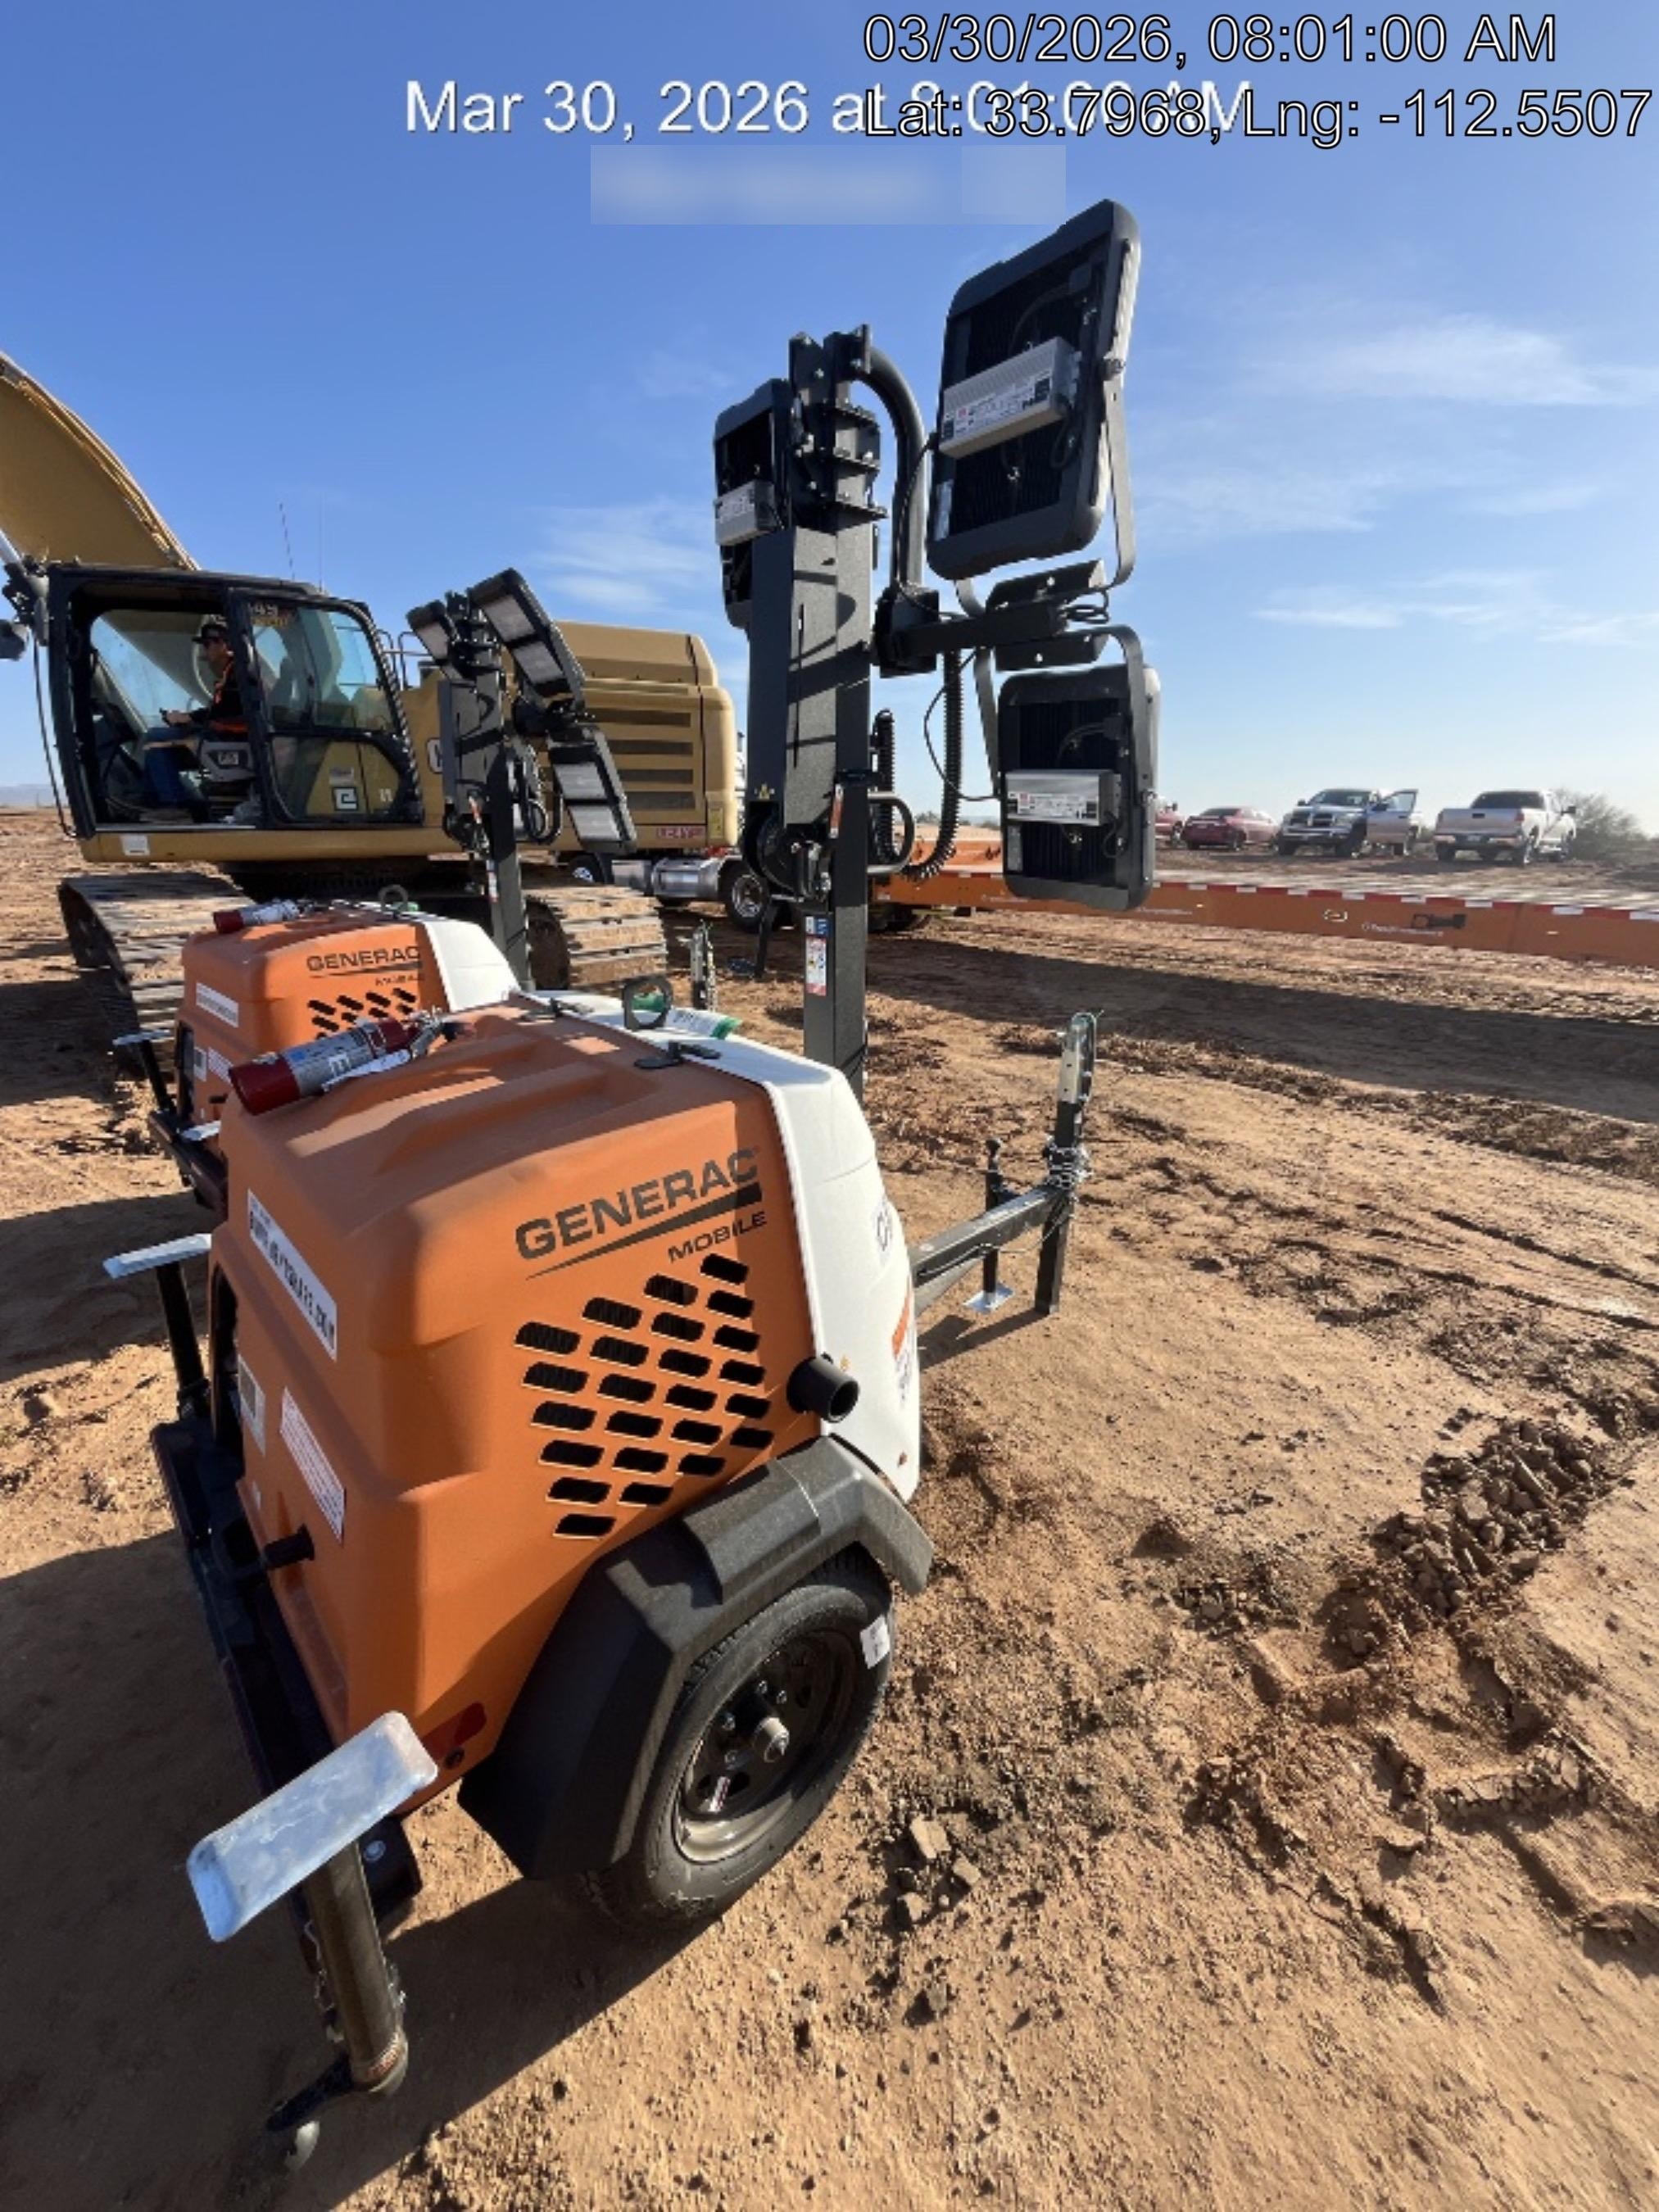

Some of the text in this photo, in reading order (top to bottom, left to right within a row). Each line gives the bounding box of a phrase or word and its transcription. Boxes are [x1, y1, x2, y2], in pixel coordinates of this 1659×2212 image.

[306, 945, 420, 971] GENERAC
[515, 1149, 758, 1260] GENERAC
[667, 1210, 768, 1263] MOBILE
